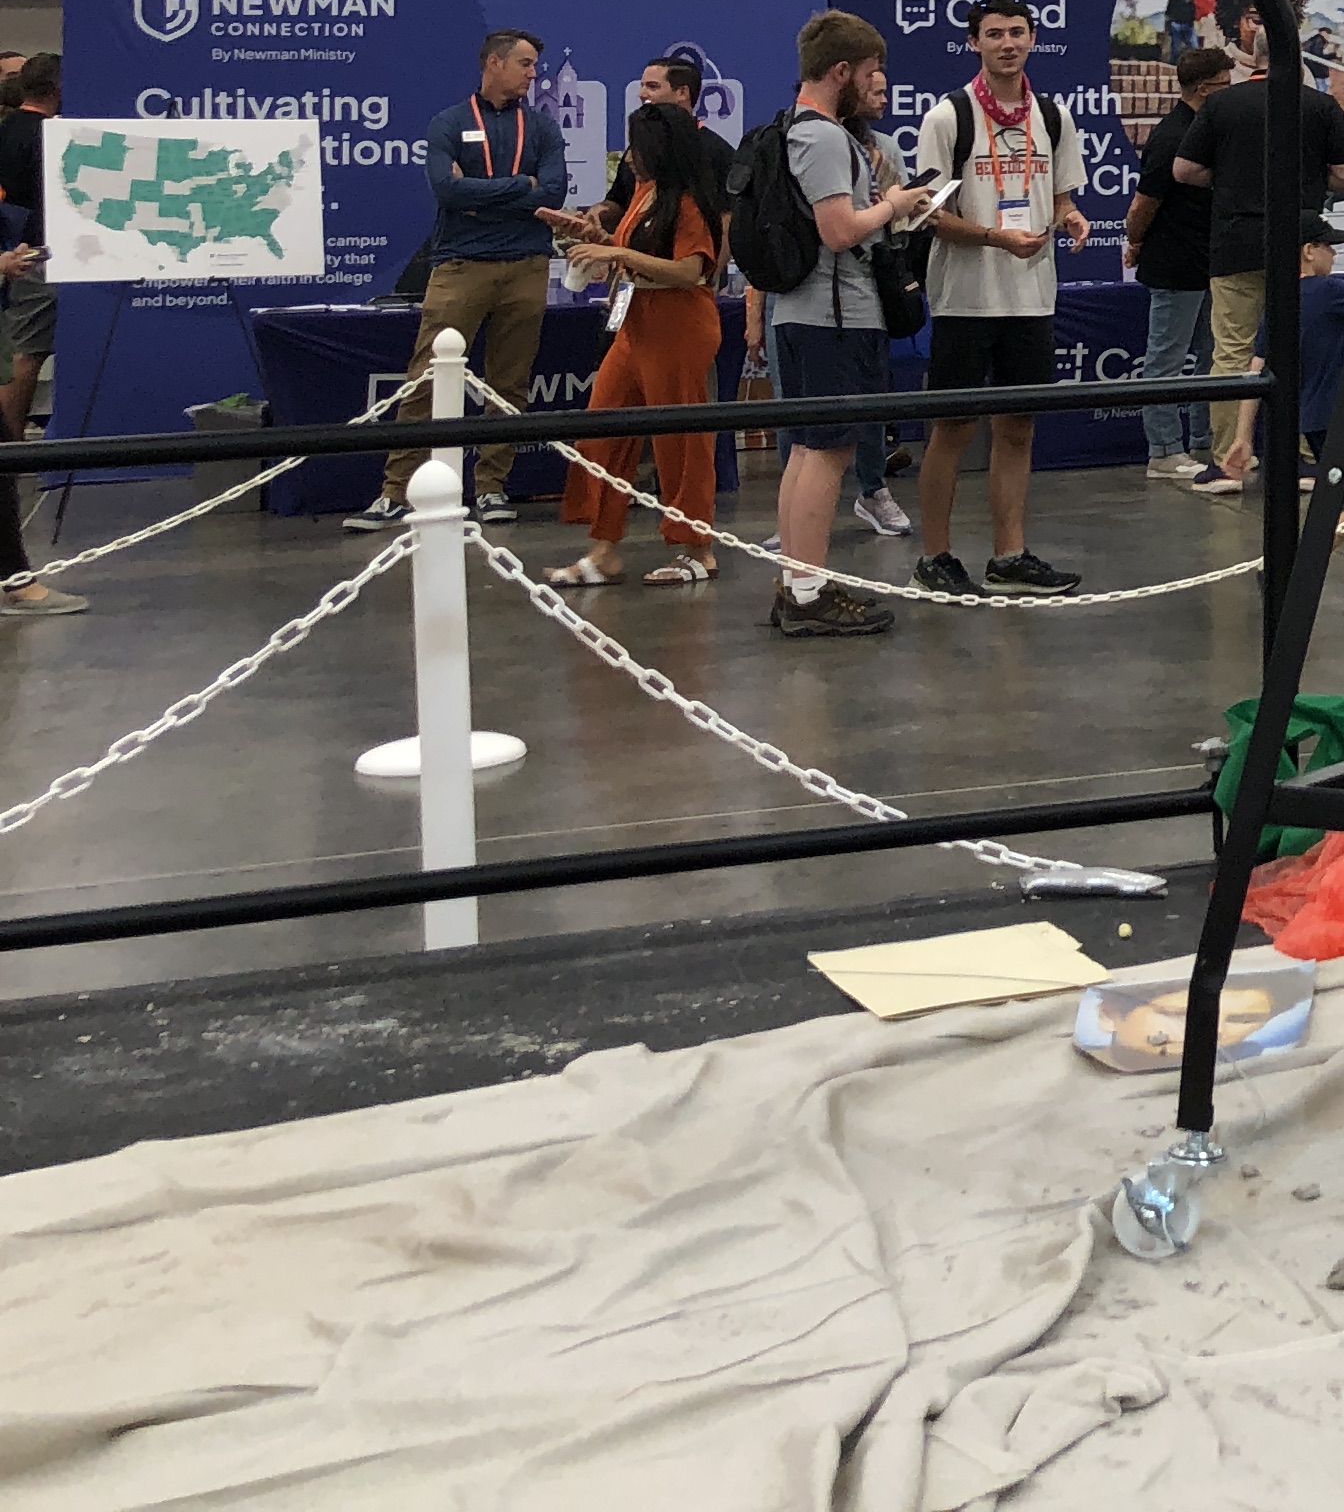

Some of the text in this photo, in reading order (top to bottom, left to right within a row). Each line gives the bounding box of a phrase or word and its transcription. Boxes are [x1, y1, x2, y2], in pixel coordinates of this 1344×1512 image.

[211, 22, 364, 37] CONNECTION
[211, 48, 356, 63] By Newman Ministry
[946, 41, 1068, 56] By inistry
[136, 88, 389, 130] Cultivating
[327, 235, 388, 248] campus
[344, 252, 376, 265] that
[315, 272, 373, 286] college
[131, 292, 233, 310] and beyond.
